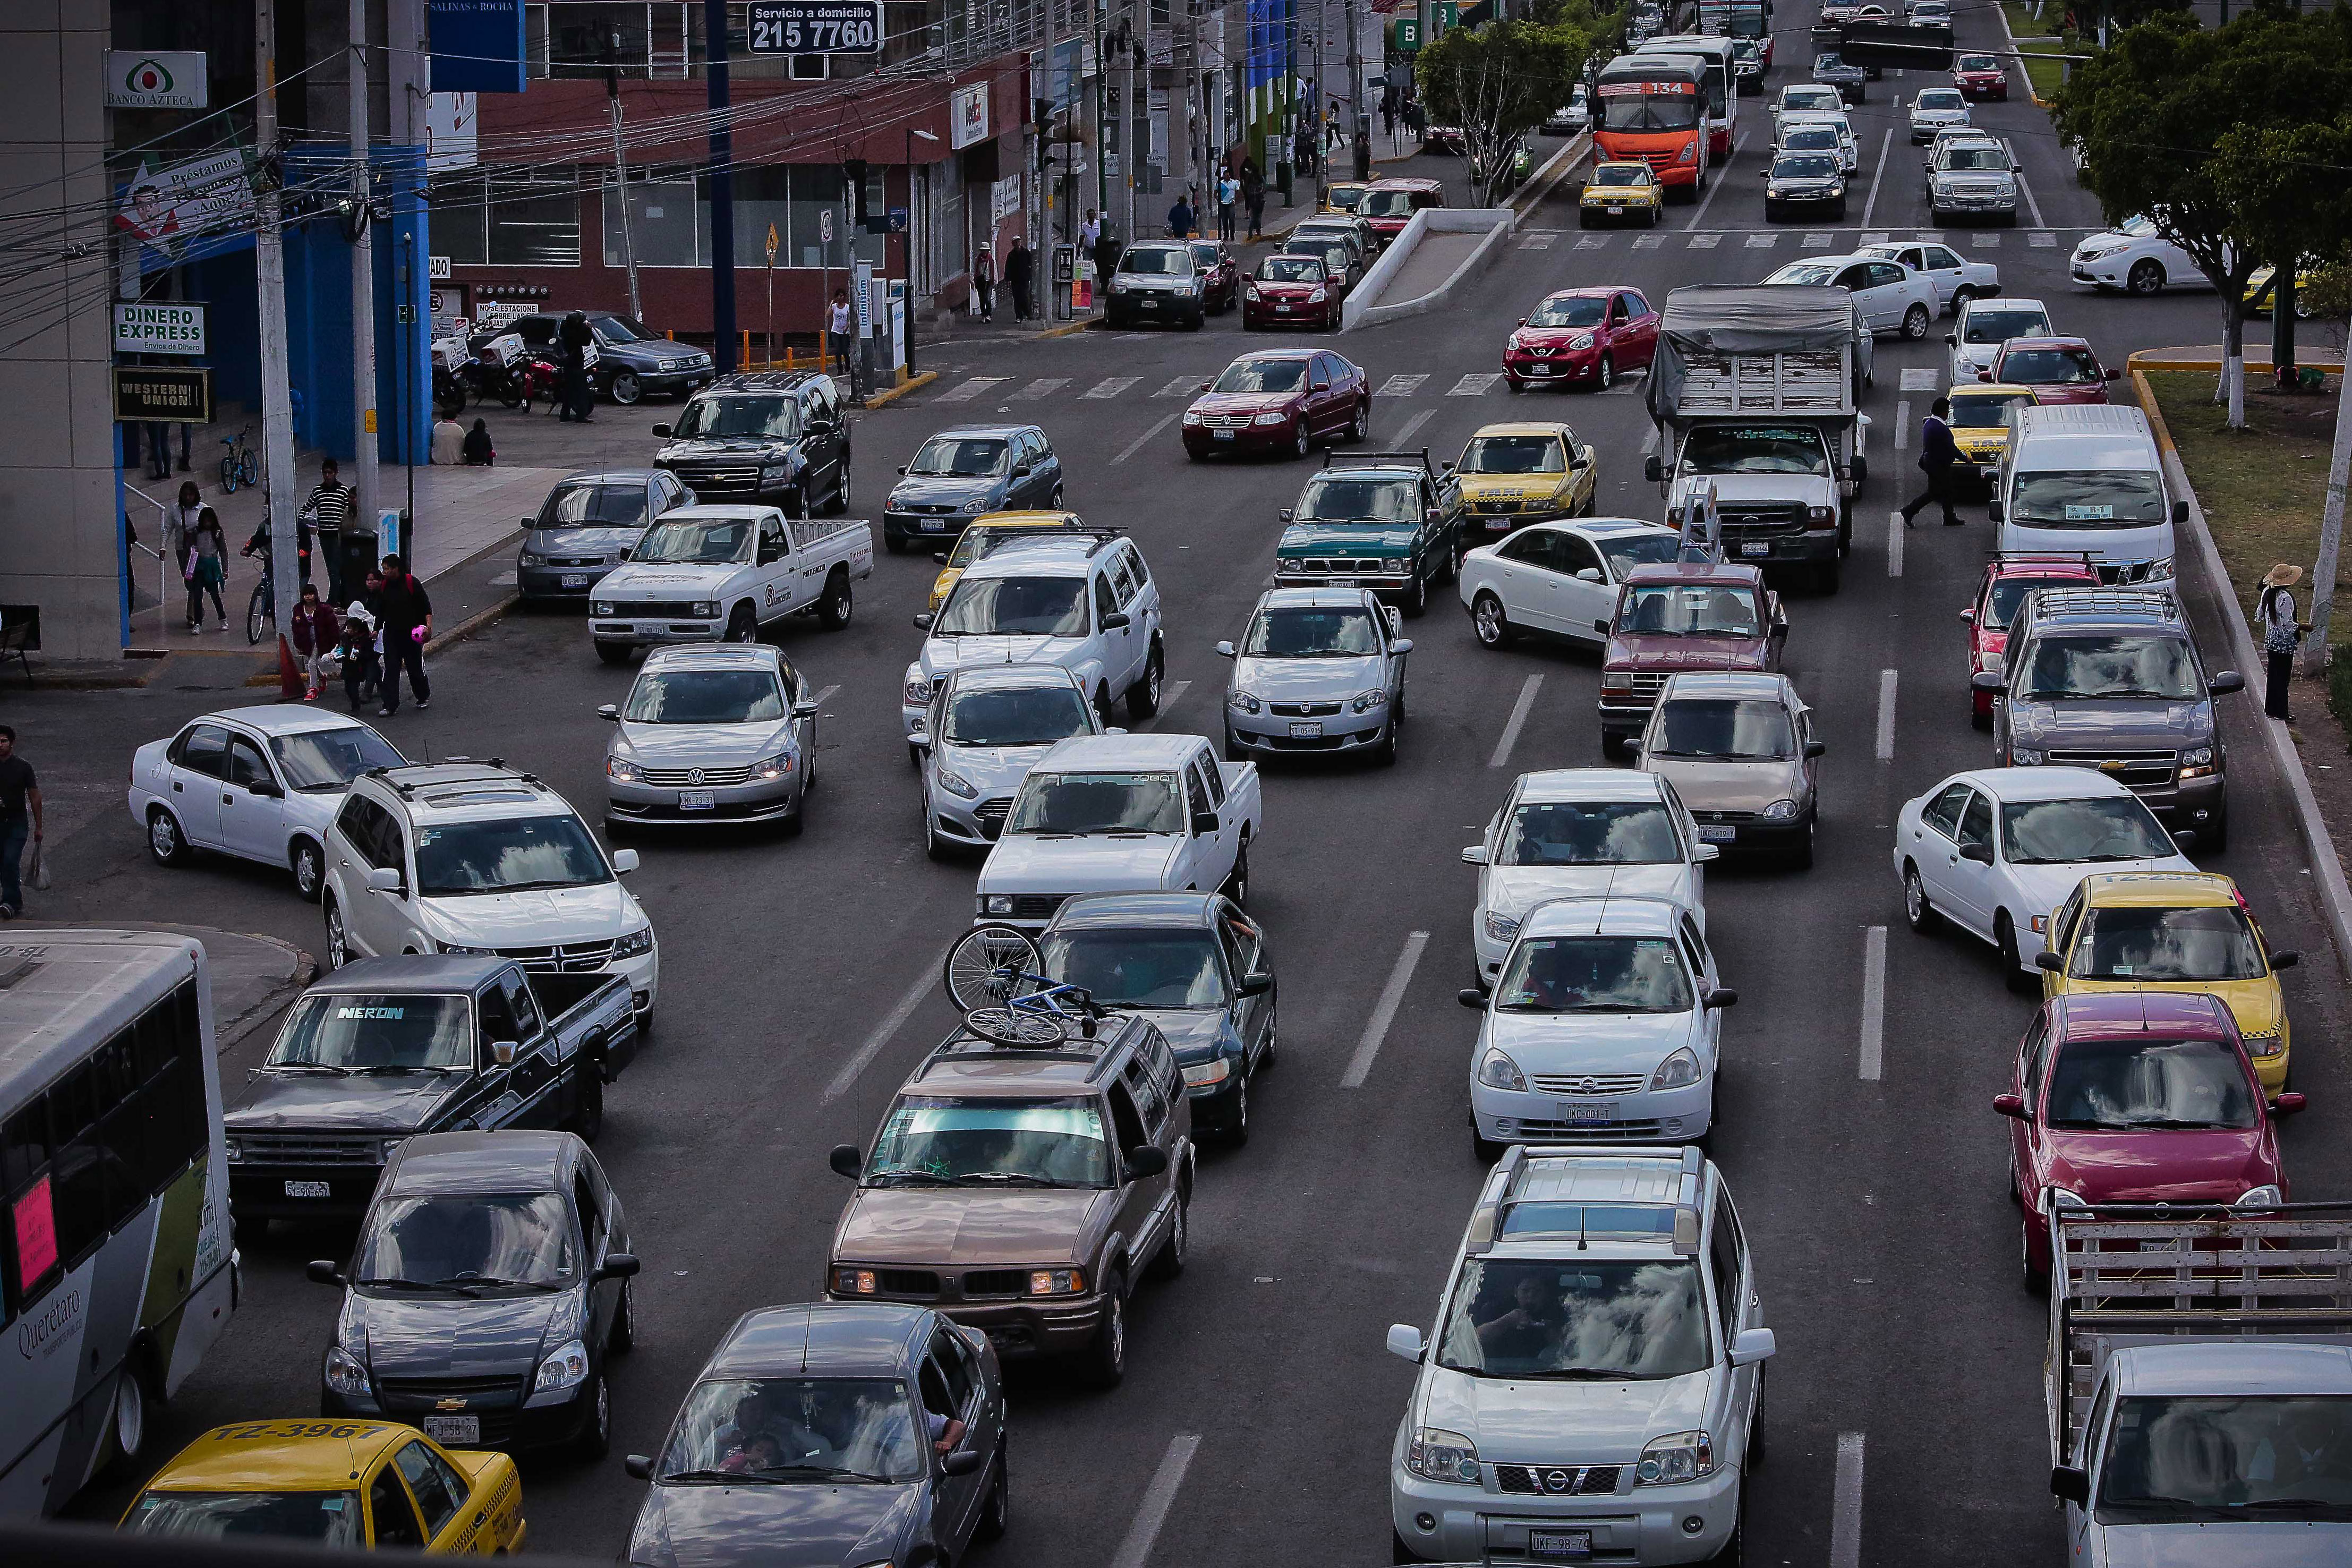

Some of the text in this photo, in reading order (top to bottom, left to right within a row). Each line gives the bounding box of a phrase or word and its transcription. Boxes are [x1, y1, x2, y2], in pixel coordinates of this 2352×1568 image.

[755, 7, 803, 18] Servicio
[817, 7, 872, 18] domicilio
[754, 21, 873, 47] 215 7760
[1405, 25, 1415, 41] B
[1651, 82, 1682, 94] 134
[108, 93, 194, 106] BANCO AZTECA
[171, 157, 238, 185] Préstamos
[430, 259, 447, 275] ADO
[124, 308, 193, 324] DINERO
[119, 324, 200, 340] EXPRESS
[121, 384, 187, 395] WESTERN
[143, 395, 188, 405] UNION
[850, 547, 871, 561] Firestone
[802, 564, 825, 579] POTENZA
[1700, 829, 1734, 838] UKC-619-Y
[1567, 1109, 1609, 1119] UKC-001-T
[19, 1290, 80, 1361] Querétaro
[214, 1424, 389, 1441] TZ-3967
[1533, 1538, 1589, 1550] UKF-98-74
